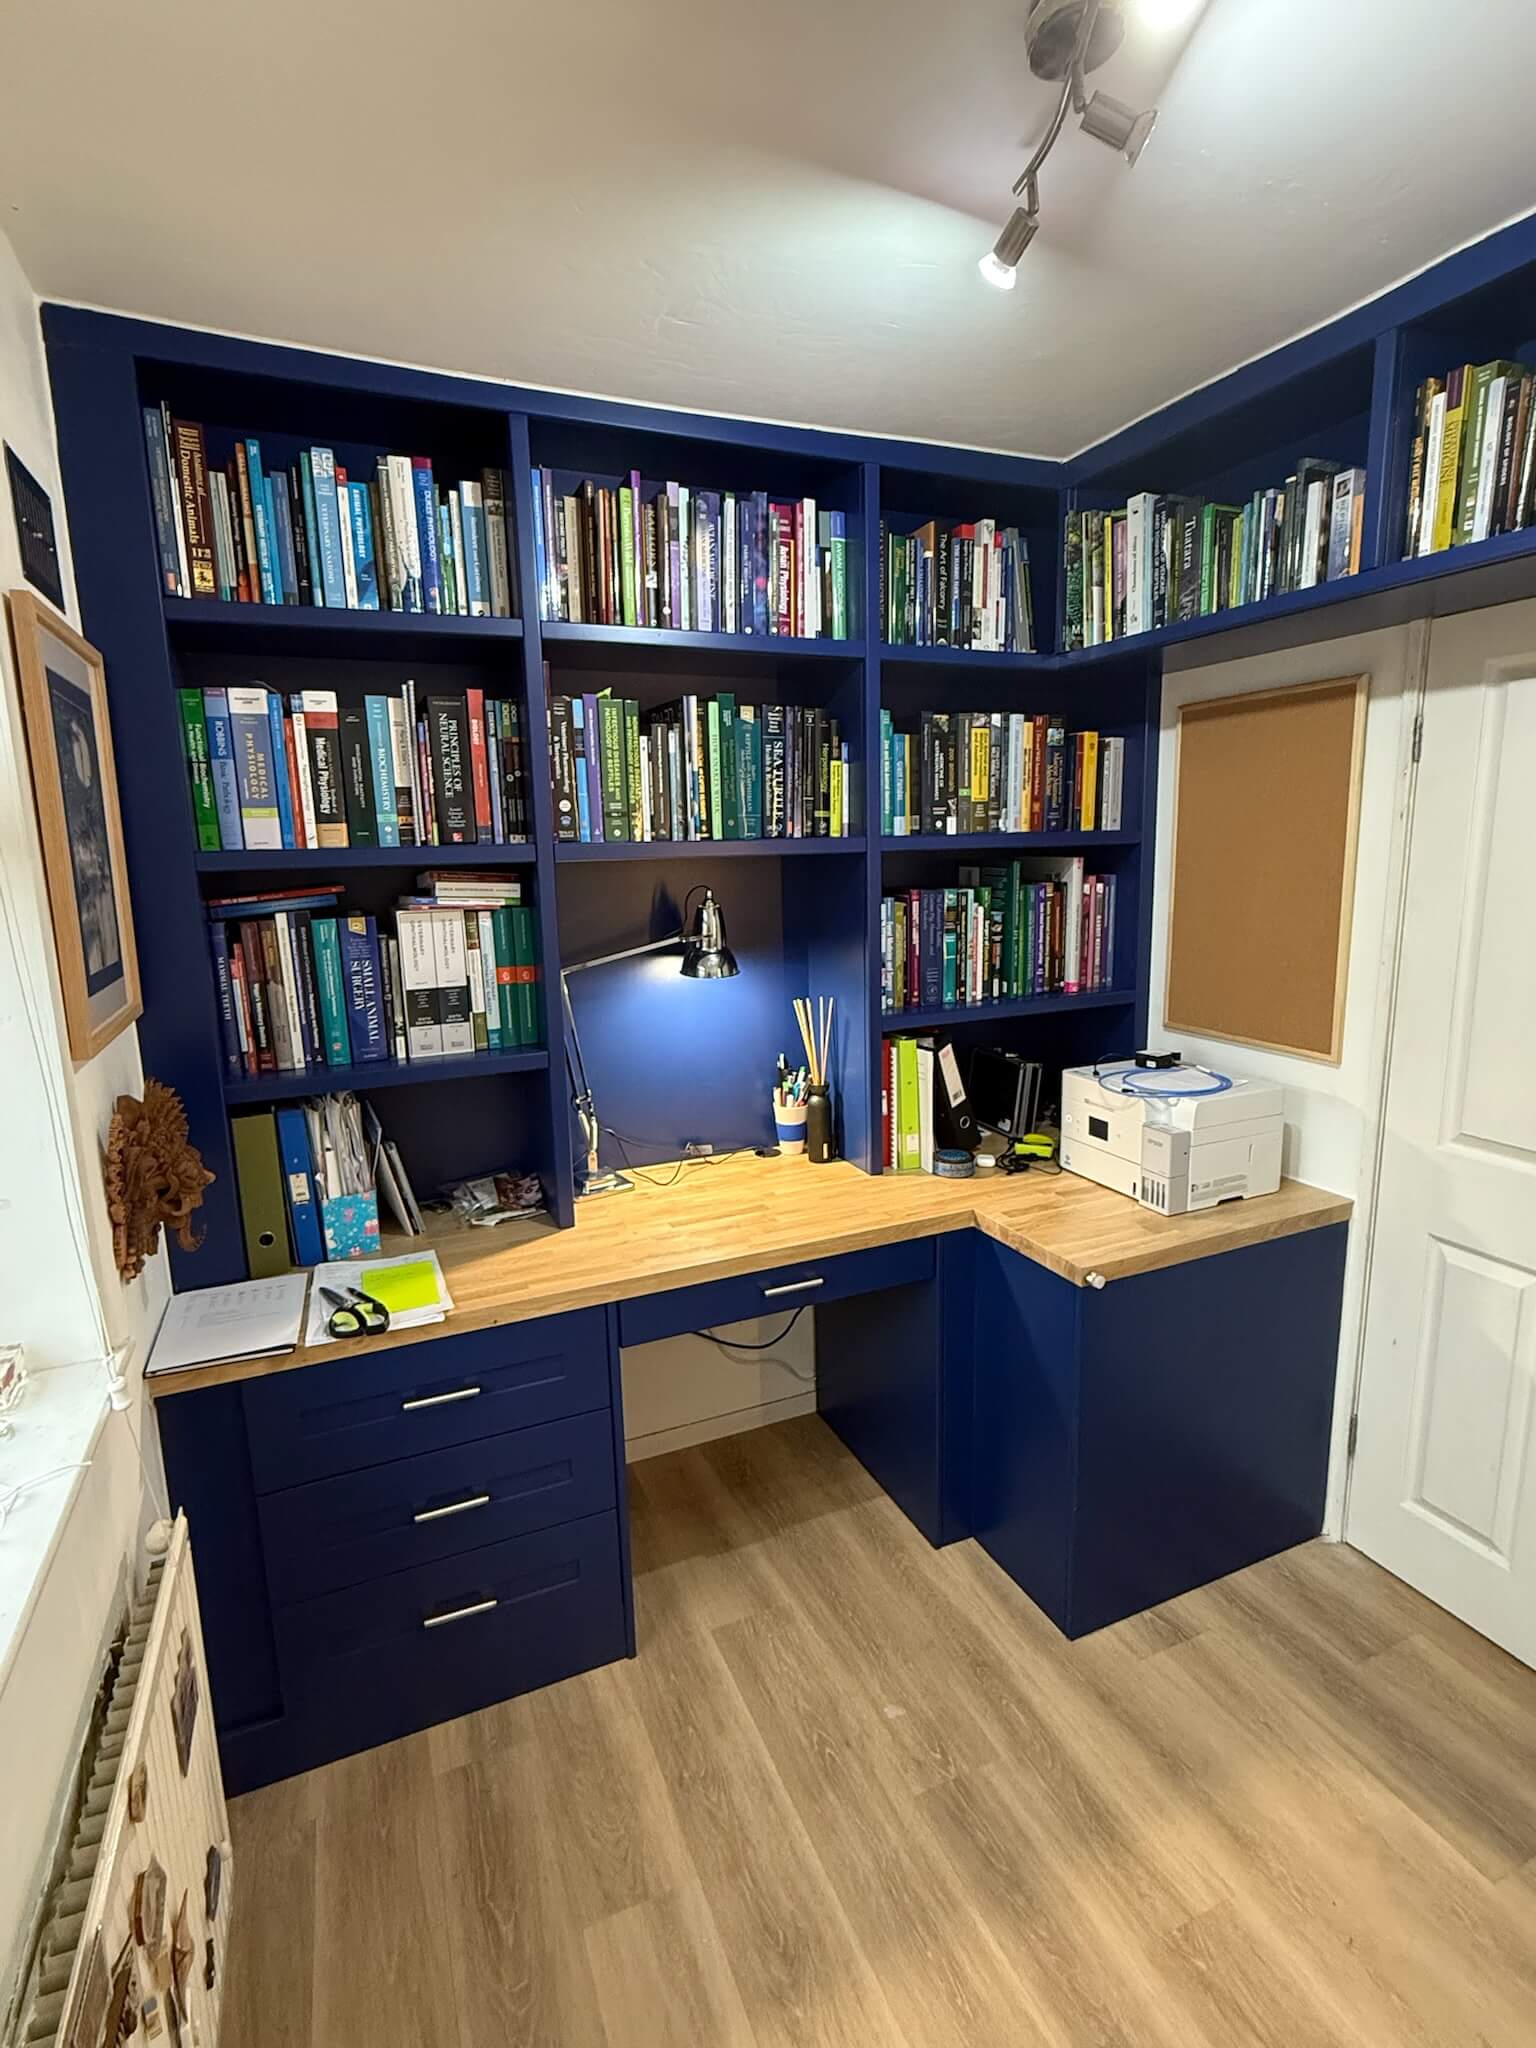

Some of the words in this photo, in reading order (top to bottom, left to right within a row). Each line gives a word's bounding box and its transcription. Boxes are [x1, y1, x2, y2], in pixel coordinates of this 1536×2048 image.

[180, 450, 192, 498] Domestic
[186, 500, 199, 544] Animals
[353, 489, 364, 516] ANIMAL
[355, 517, 367, 559] PHYSIOLOGY
[779, 545, 790, 569] Avian
[836, 542, 844, 570] AVIAN
[940, 533, 948, 549] The
[1183, 515, 1197, 570] Tuatara
[939, 550, 948, 565] Art
[940, 566, 948, 575] of
[779, 570, 790, 615] Physiology
[938, 576, 948, 610] Falconry
[194, 723, 207, 761] Functional
[214, 720, 228, 757] ROBBINS
[438, 713, 451, 754] NEURAL
[471, 718, 480, 746] BIOLOGY
[604, 707, 612, 748] PATHOLOGY
[611, 707, 619, 750] INFECTIOUS
[711, 734, 719, 756] HOW
[245, 732, 259, 800] PHYSIOLOGY
[314, 737, 329, 769] Medical
[448, 719, 463, 777] PRINCIPLES
[773, 740, 784, 767] SEA
[198, 763, 211, 809] Biochemistry
[256, 752, 270, 800] MEDICAL
[376, 747, 391, 812] BIOCHEMISTRY
[442, 755, 454, 799] SCIENCE
[453, 778, 463, 793] OF
[607, 758, 615, 792] REPTILES
[612, 751, 621, 786] DISEASES
[820, 742, 830, 793] Herpetology
[318, 770, 333, 815] Physiology
[628, 773, 637, 805] REPTILES
[773, 768, 784, 820] TURTLE
[216, 956, 228, 992] MAMMAL
[351, 960, 365, 1011] SURGERY
[360, 959, 374, 997] SMALL
[221, 993, 232, 1020] TEETH
[366, 999, 380, 1044] ANIMAL
